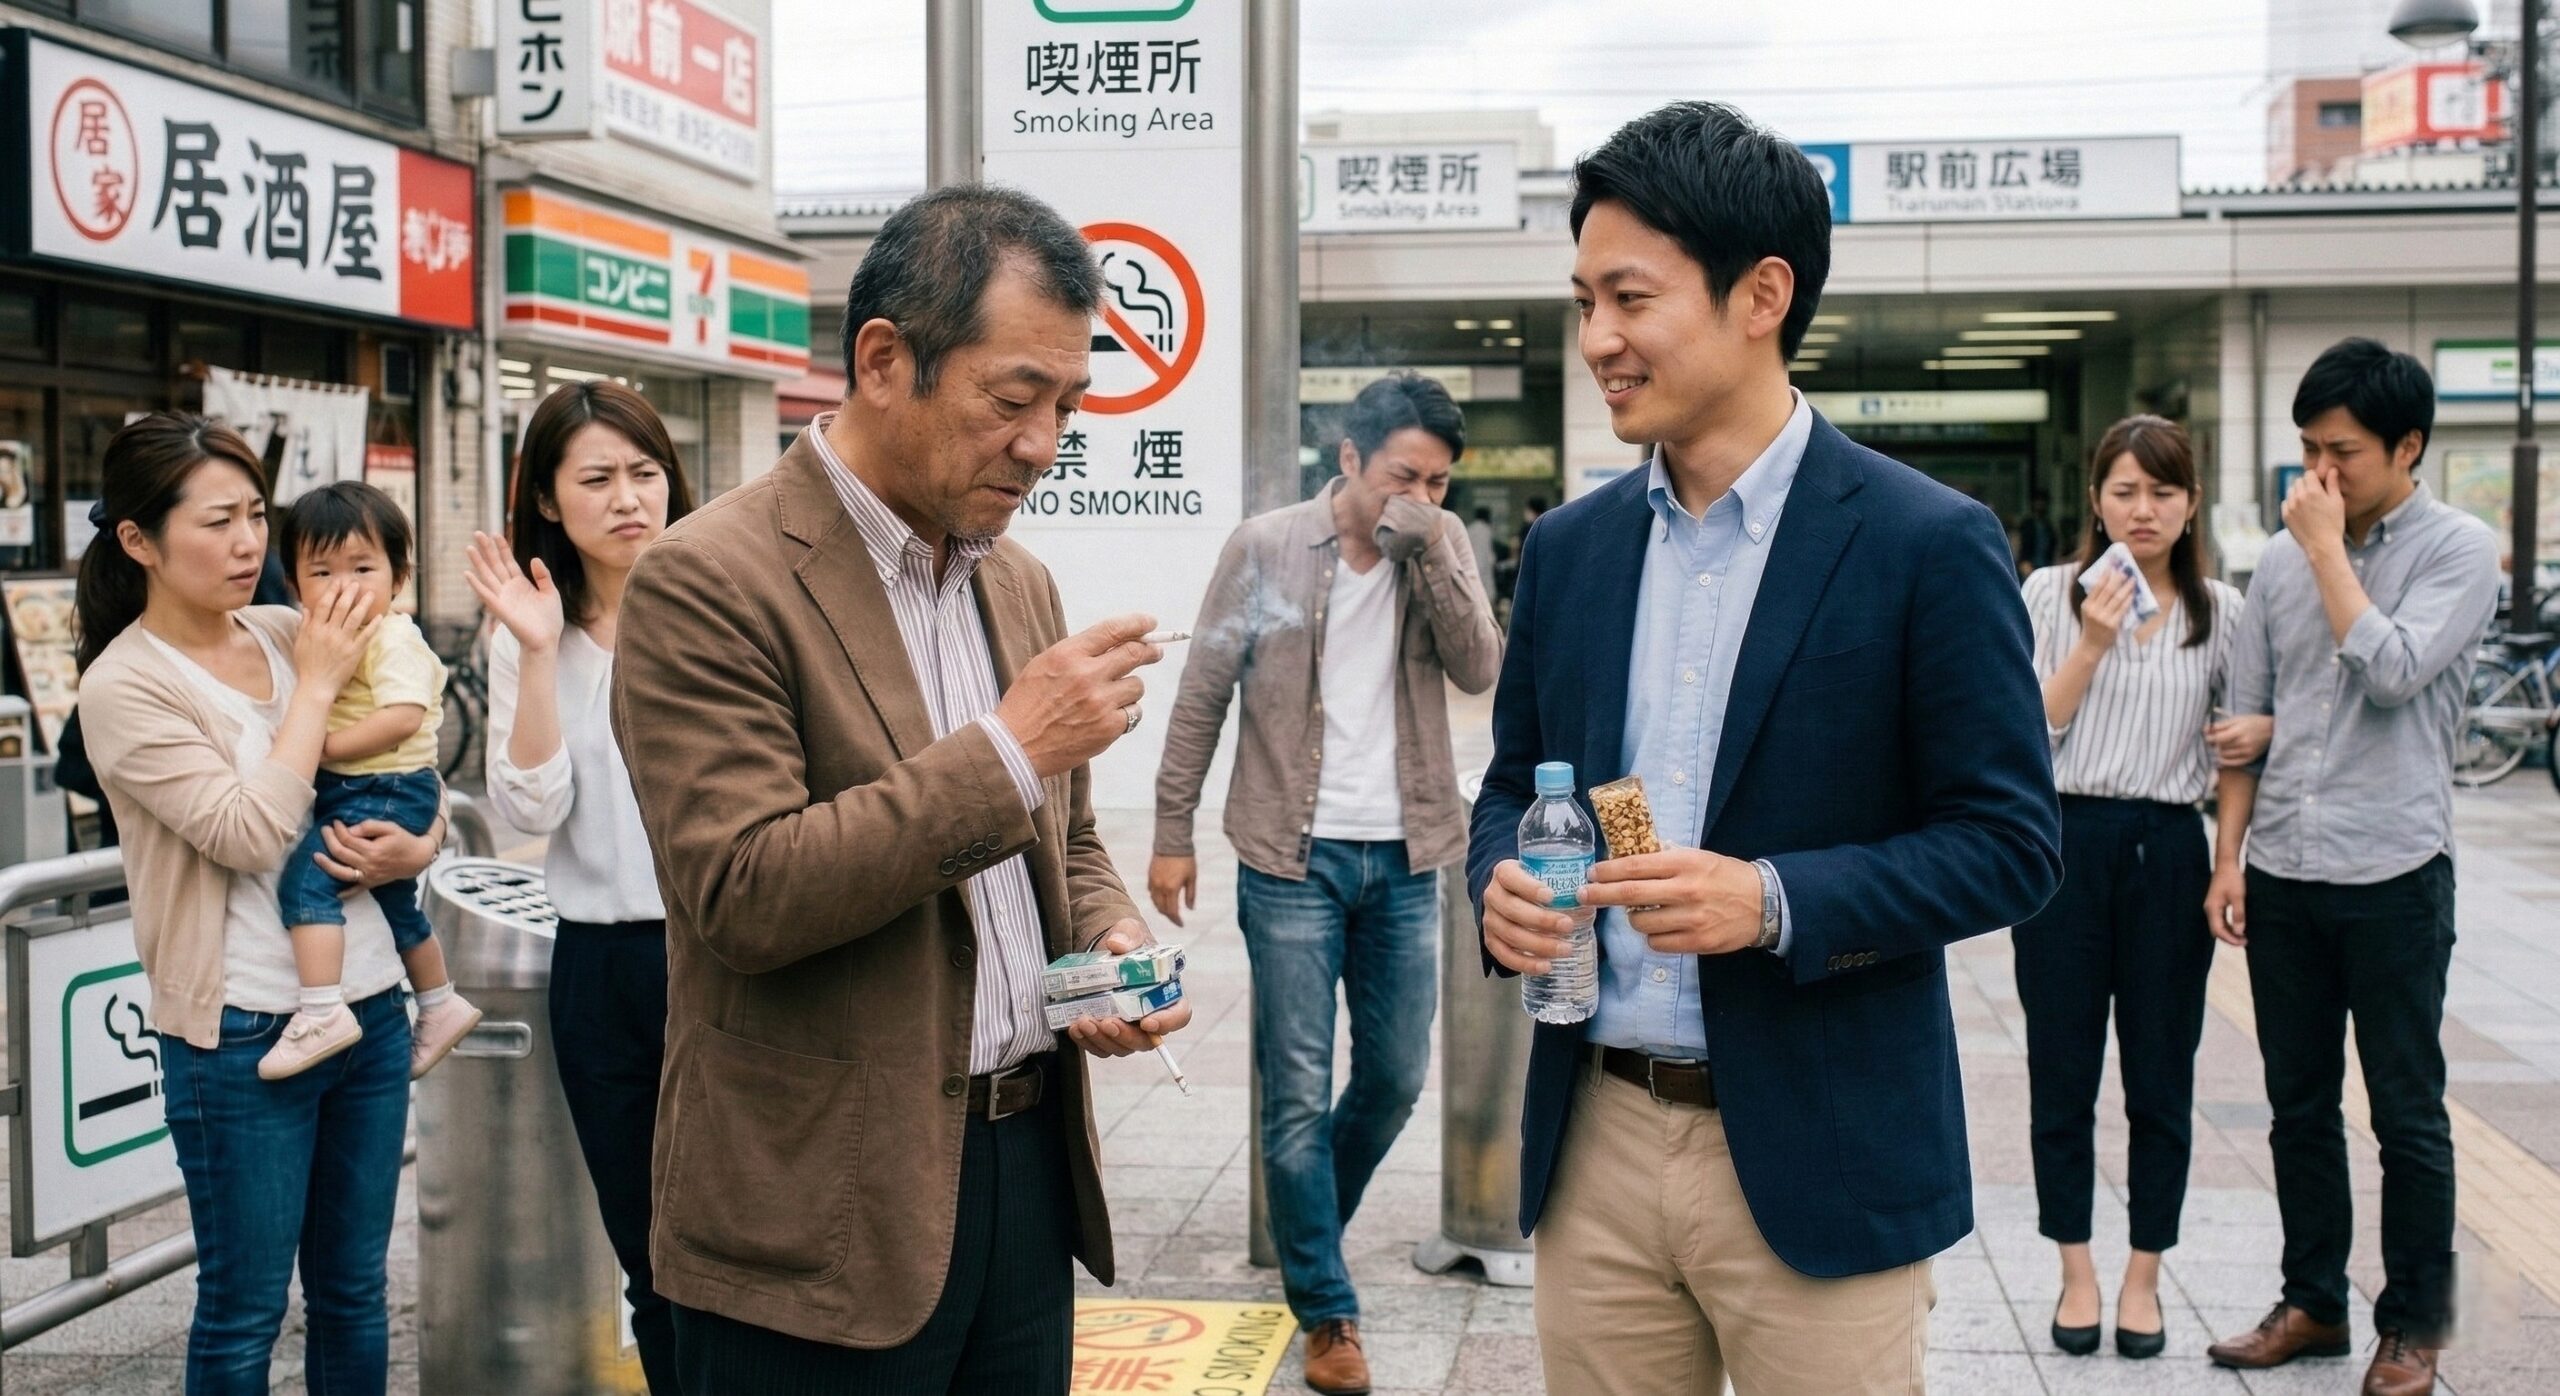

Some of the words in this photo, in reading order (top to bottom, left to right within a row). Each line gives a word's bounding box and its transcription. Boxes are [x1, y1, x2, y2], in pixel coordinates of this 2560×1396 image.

[1026, 38, 1201, 96] 喫煙所
[1013, 107, 1137, 139] Smoking
[1146, 107, 1214, 131] Area
[1337, 153, 1481, 195] 喫煙所
[1886, 148, 2082, 190] 駅前広場
[151, 117, 383, 282] 居酒屋
[1433, 201, 1480, 217] Area
[586, 255, 668, 313] コンビニ
[1020, 490, 1060, 516] NO
[1069, 489, 1203, 516] SMOKING
[1203, 1309, 1284, 1382] SMOKING
